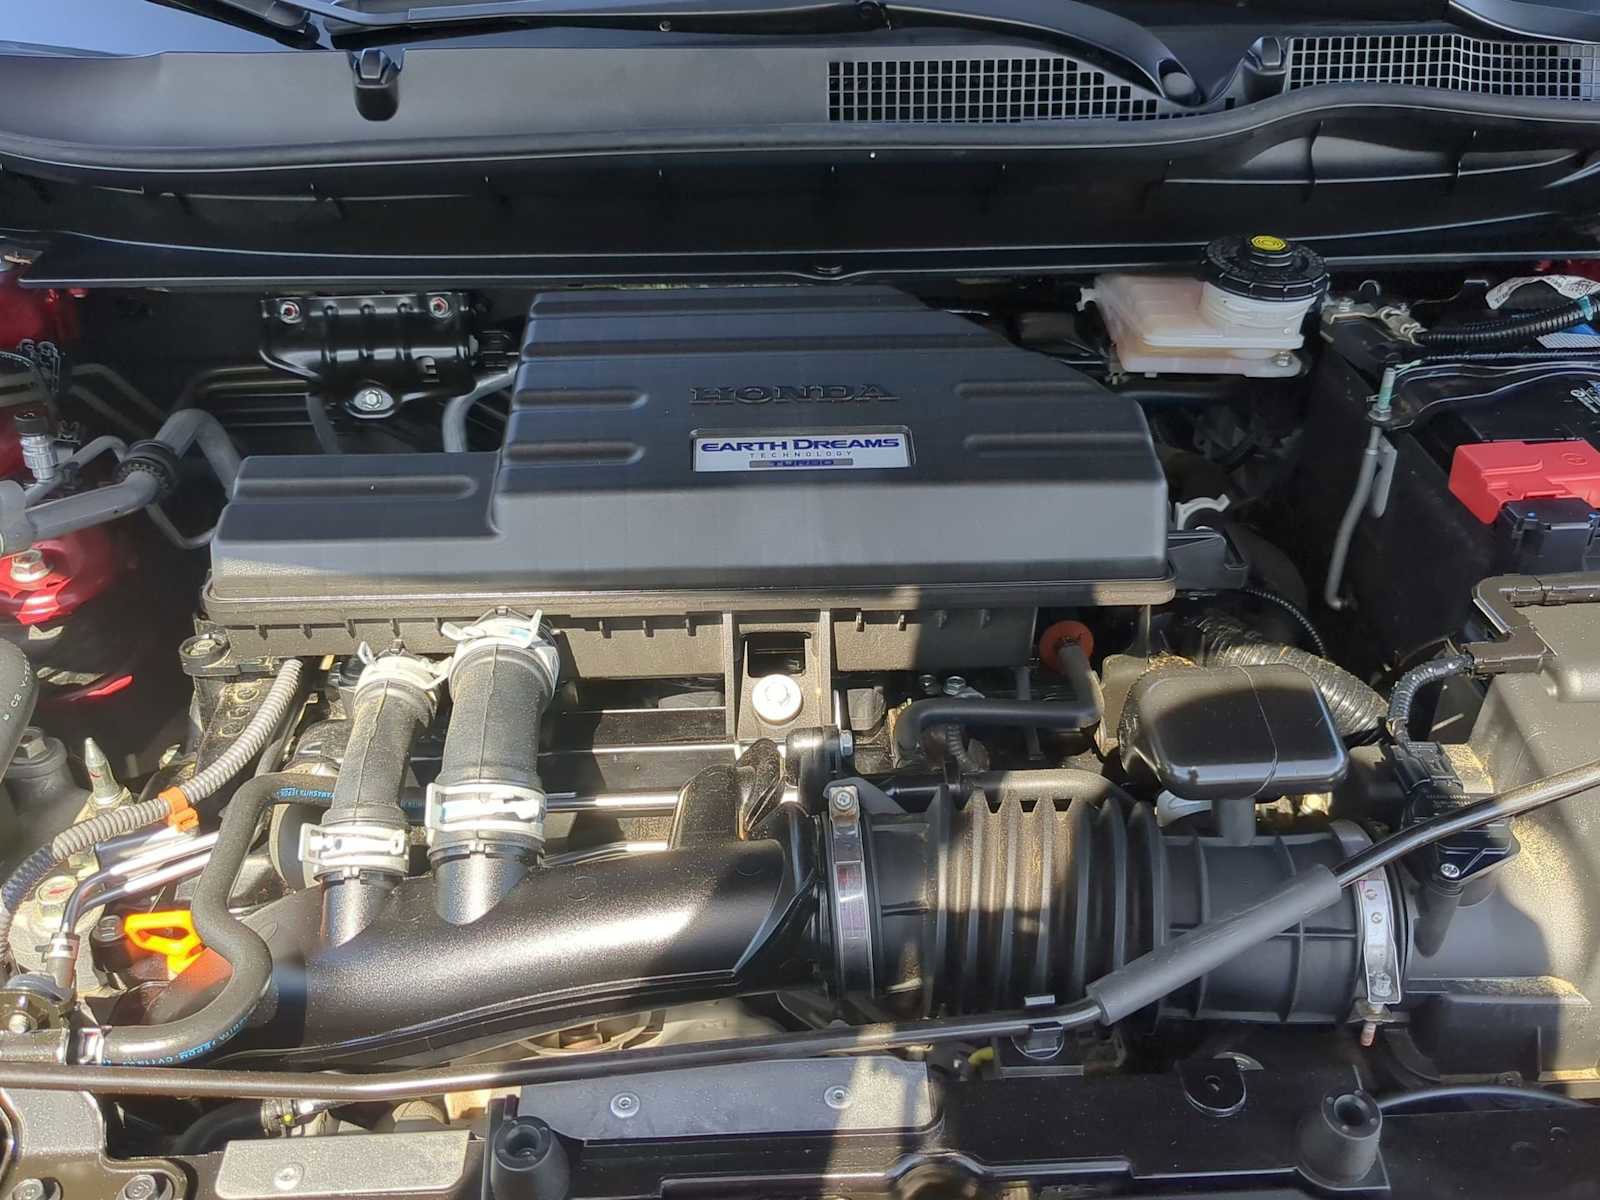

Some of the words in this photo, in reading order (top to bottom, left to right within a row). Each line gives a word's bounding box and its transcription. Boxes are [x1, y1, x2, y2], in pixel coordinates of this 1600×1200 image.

[690, 384, 899, 404] HONDA
[701, 441, 787, 452] EARTH
[793, 438, 899, 450] DREAMS
[750, 450, 852, 458] TECHNOLOGY
[769, 459, 834, 468] TURBO
